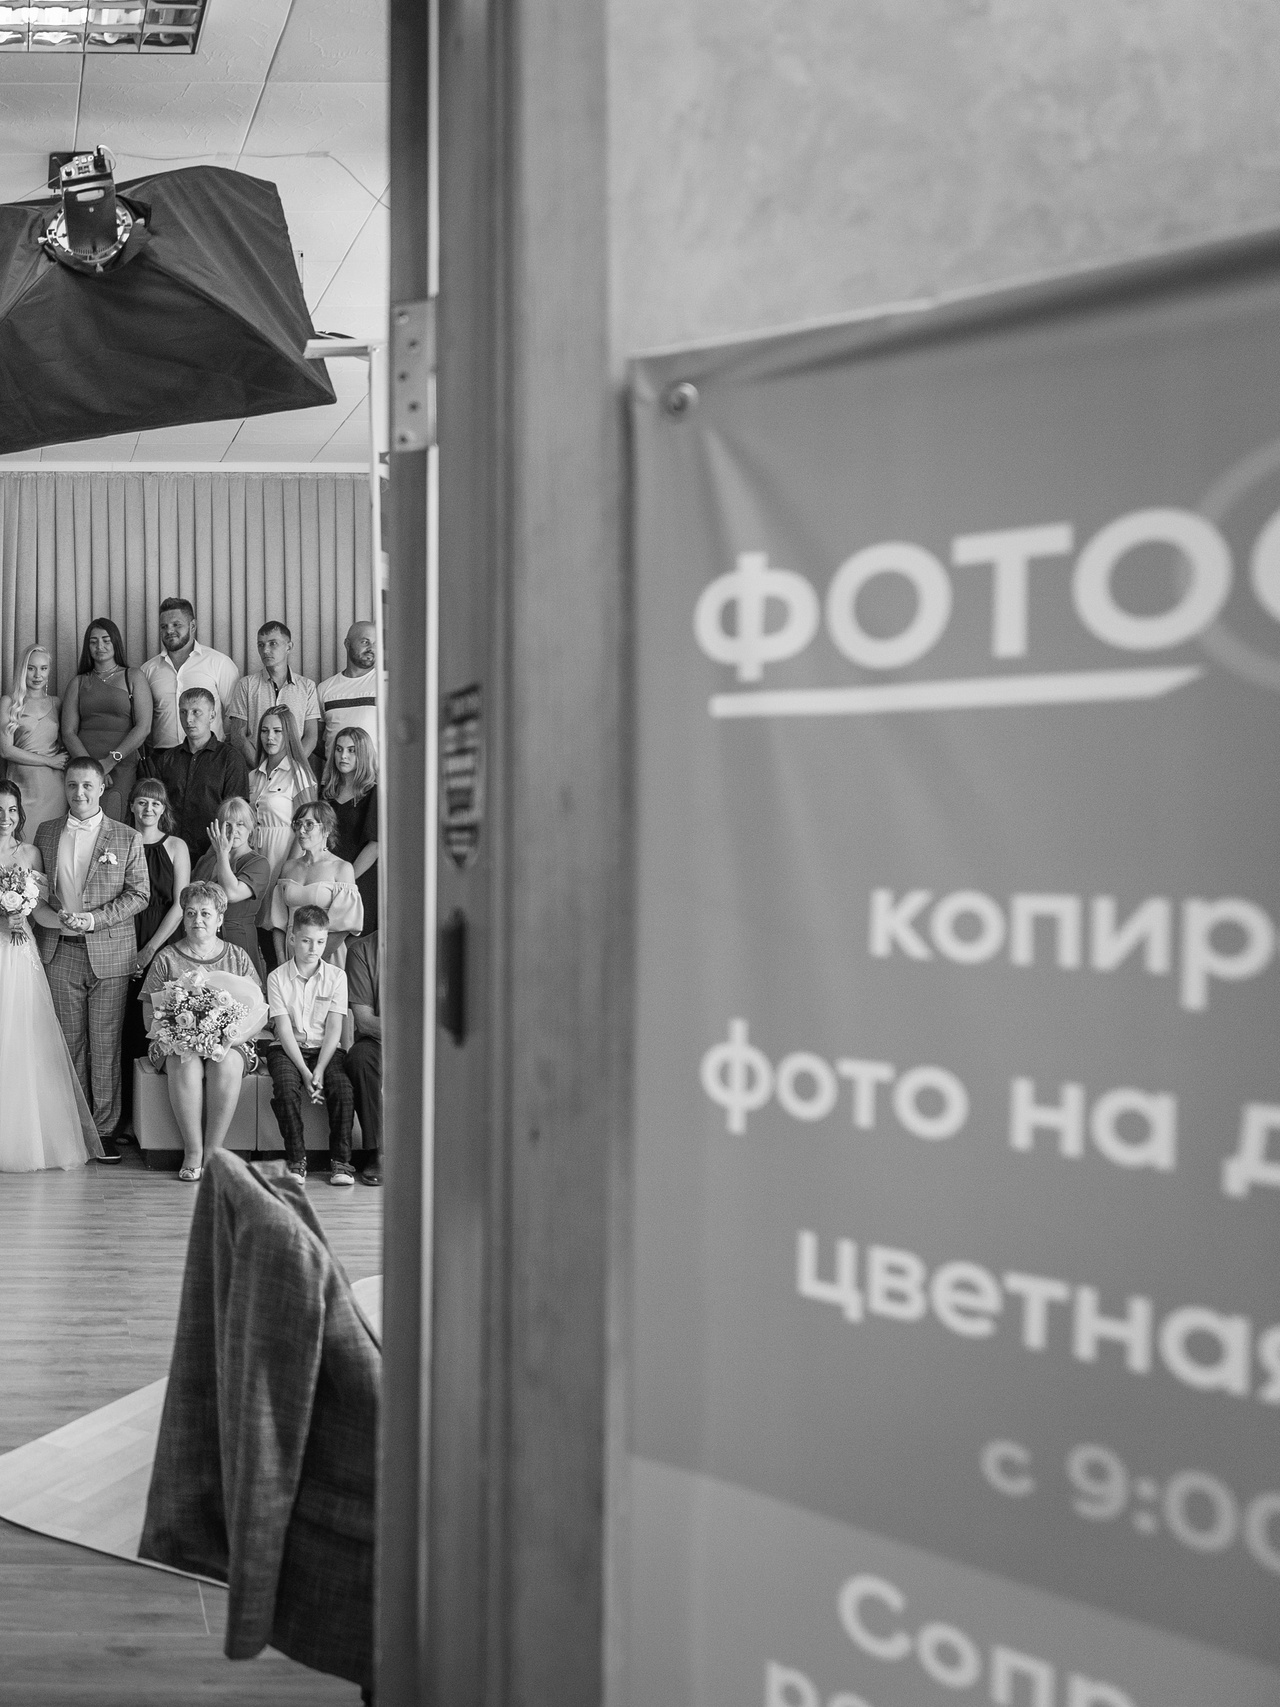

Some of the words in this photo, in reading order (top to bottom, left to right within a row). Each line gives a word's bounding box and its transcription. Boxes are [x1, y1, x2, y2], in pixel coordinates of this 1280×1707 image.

[693, 504, 1280, 683] ФОТО
[869, 887, 1277, 1011] копир
[699, 1016, 970, 1141] фото
[1011, 1077, 1176, 1172] на
